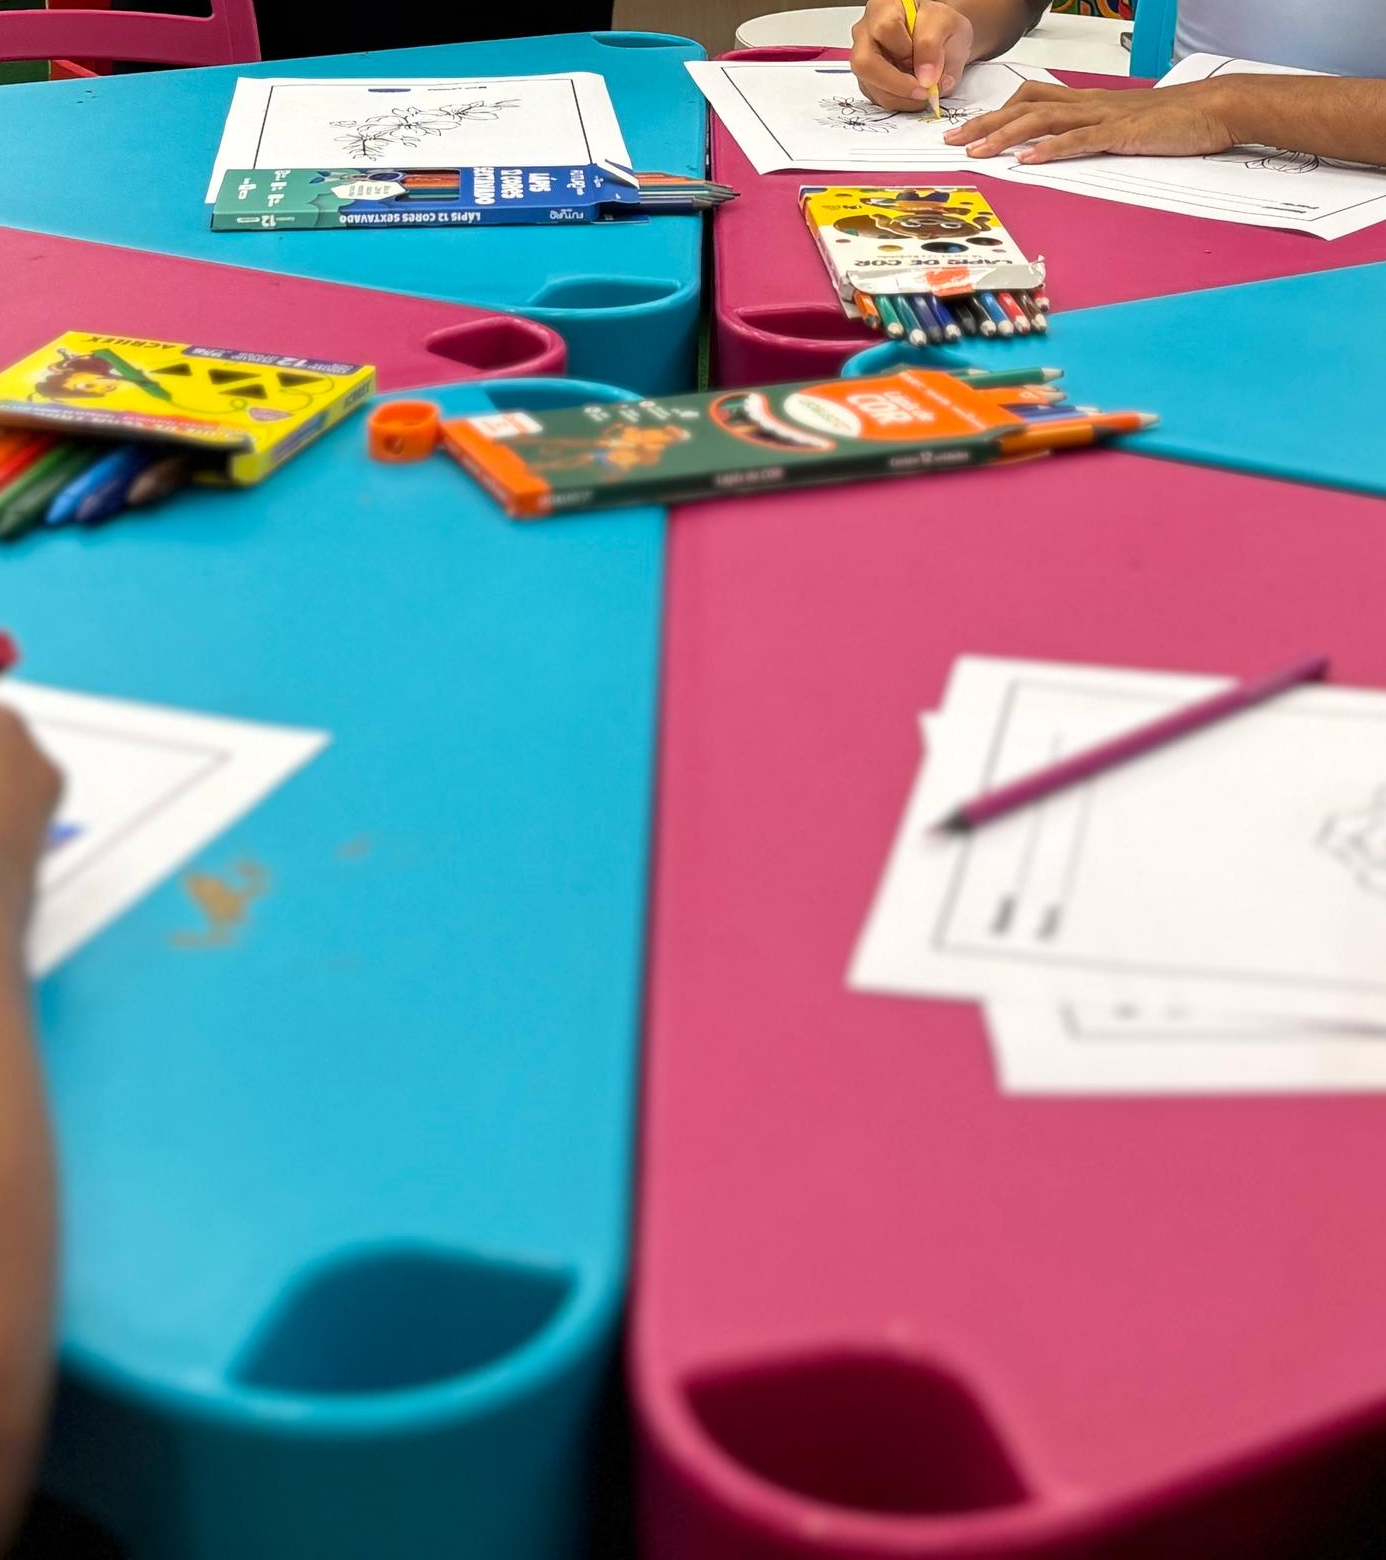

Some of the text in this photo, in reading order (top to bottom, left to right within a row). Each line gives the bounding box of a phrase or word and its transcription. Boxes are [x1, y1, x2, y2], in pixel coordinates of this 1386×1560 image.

[261, 214, 277, 227] 12
[339, 213, 400, 224] SEXTAVADO
[402, 213, 436, 223] CORES
[437, 212, 449, 221] 12
[451, 211, 480, 224] LÁPIS
[88, 337, 176, 350] ACRILEX
[846, 393, 913, 425] COR
[920, 450, 933, 464] 12
